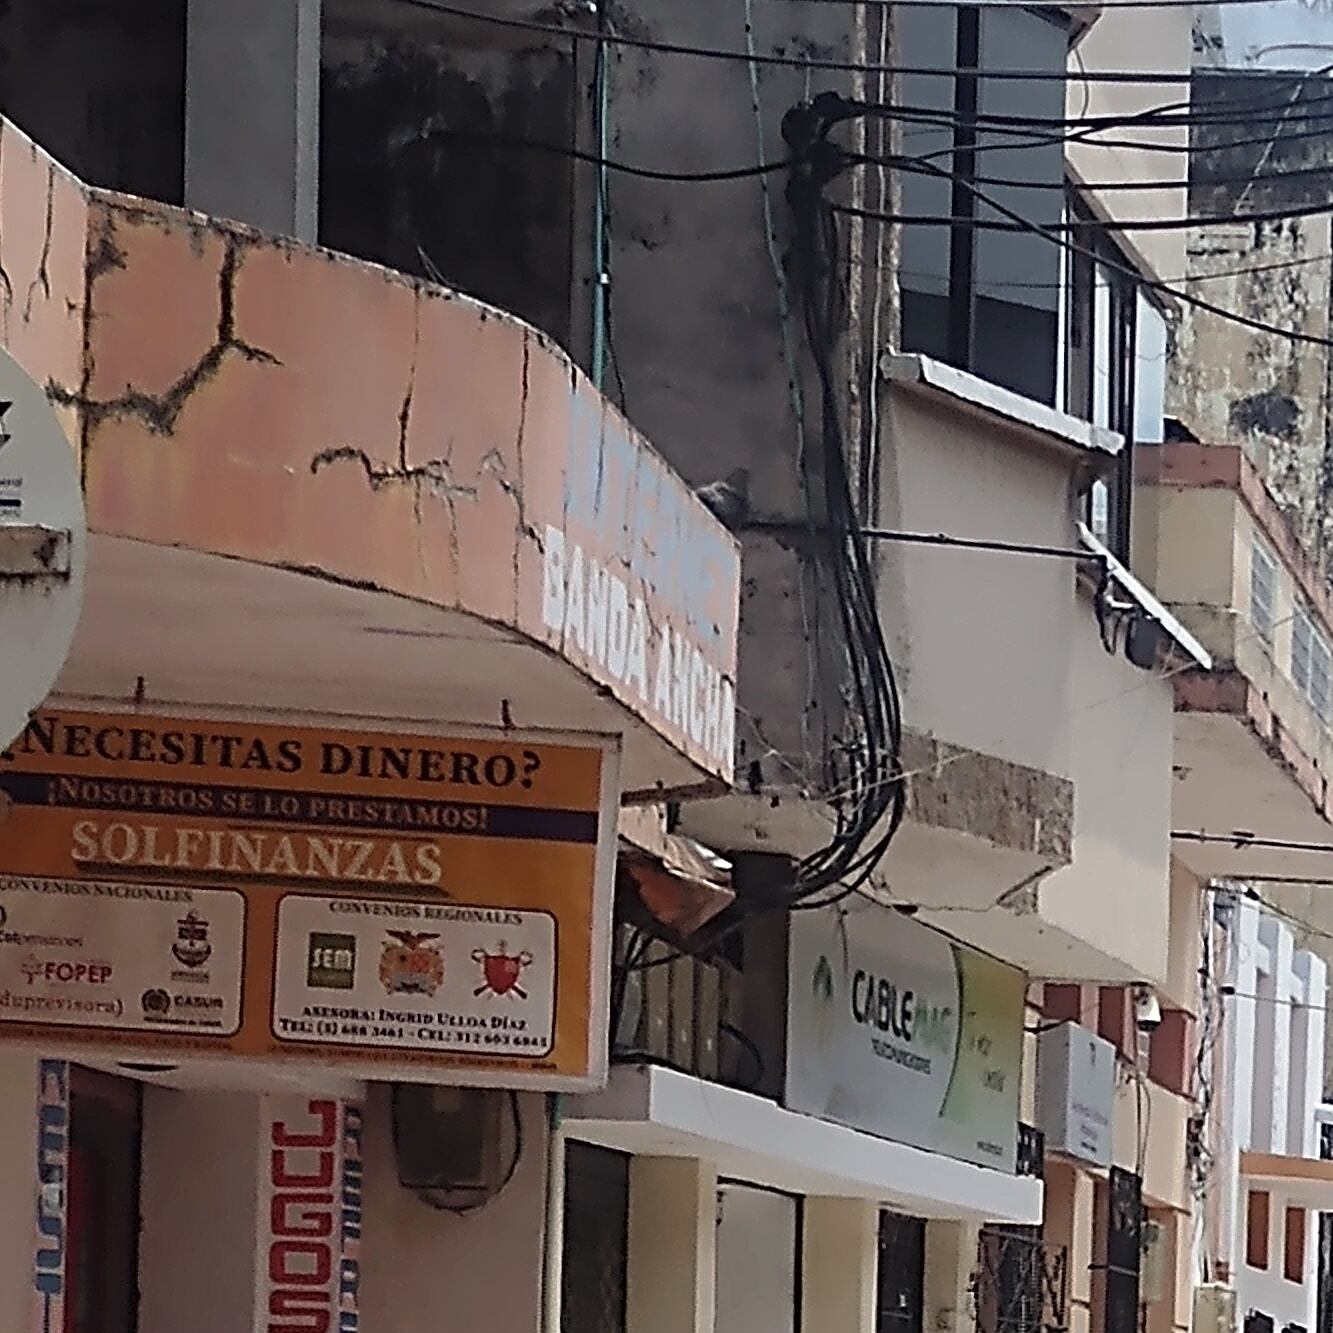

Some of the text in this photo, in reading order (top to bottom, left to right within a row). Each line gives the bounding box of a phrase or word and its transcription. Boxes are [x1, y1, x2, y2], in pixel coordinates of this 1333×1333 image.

[543, 525, 734, 786] BANDA ANCHA
[0, 716, 541, 789] NECESITAS DINERO?
[309, 798, 488, 829] PRESTAMOS!
[71, 820, 443, 885] SOLFINANZAS
[329, 901, 523, 925] CONVENIOS REGIONALES
[44, 961, 113, 985] FOPEP
